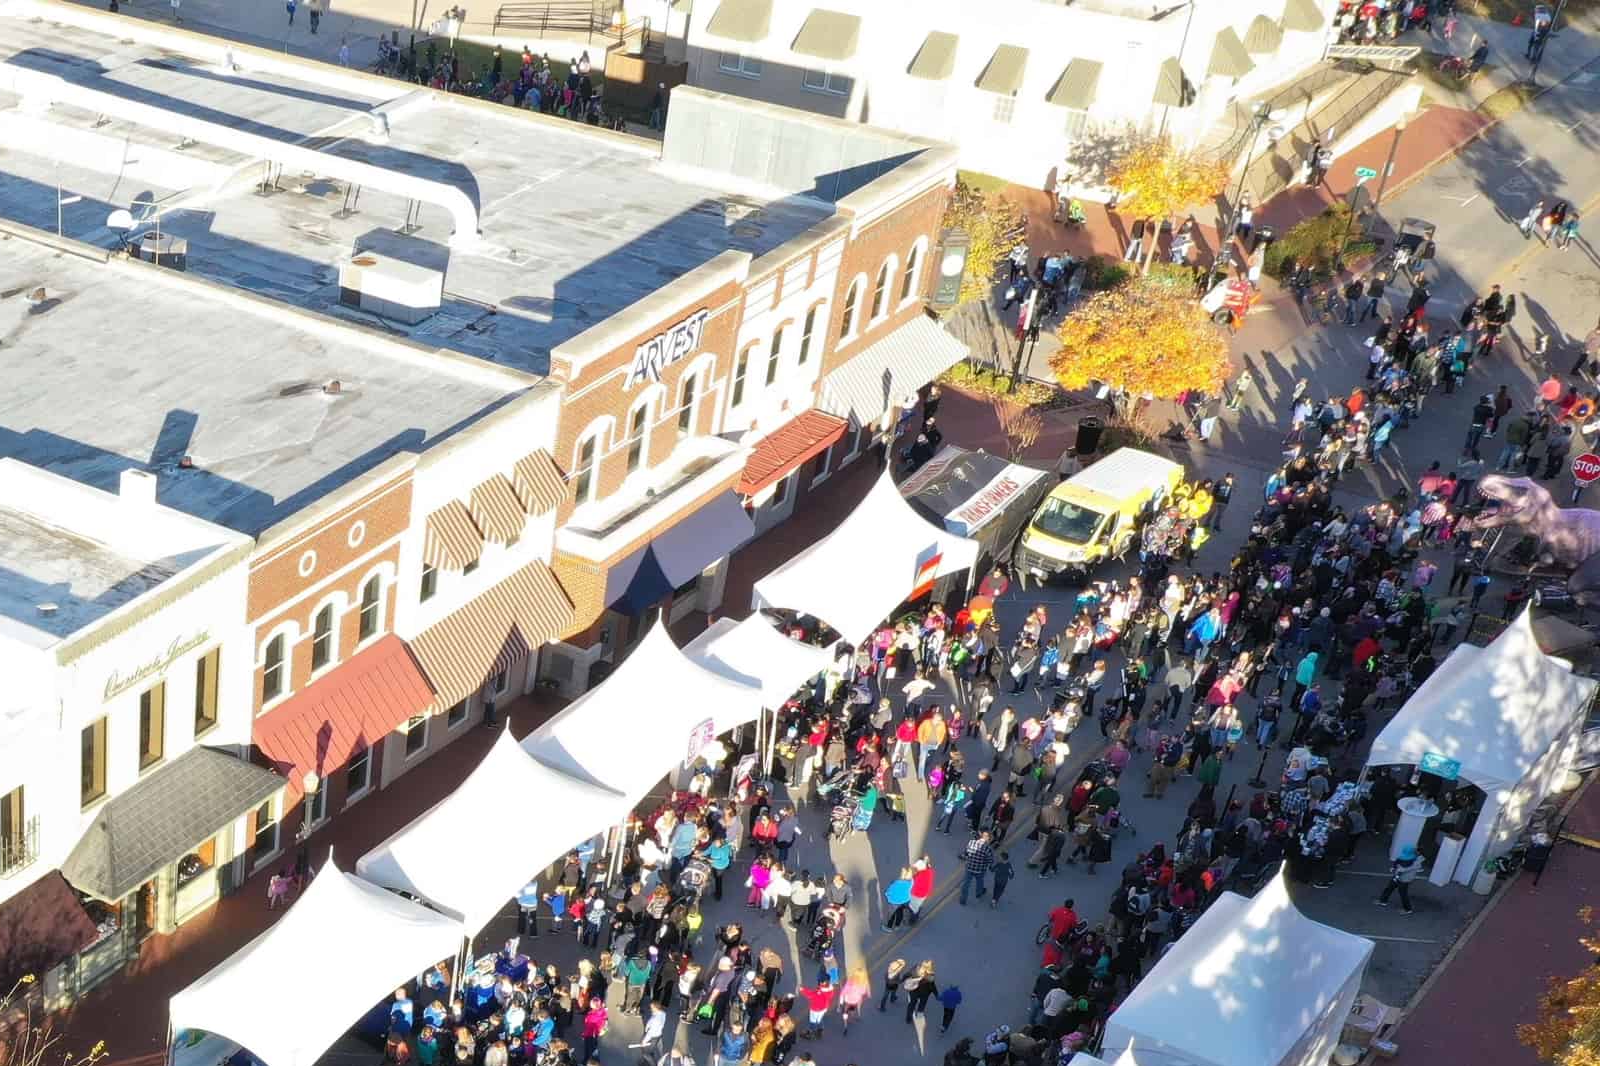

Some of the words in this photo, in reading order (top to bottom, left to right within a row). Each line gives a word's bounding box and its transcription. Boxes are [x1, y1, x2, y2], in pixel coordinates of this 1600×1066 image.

[624, 308, 709, 390] ARVEST
[1574, 460, 1600, 475] STOP
[958, 477, 1019, 526] TRANSFORMERS
